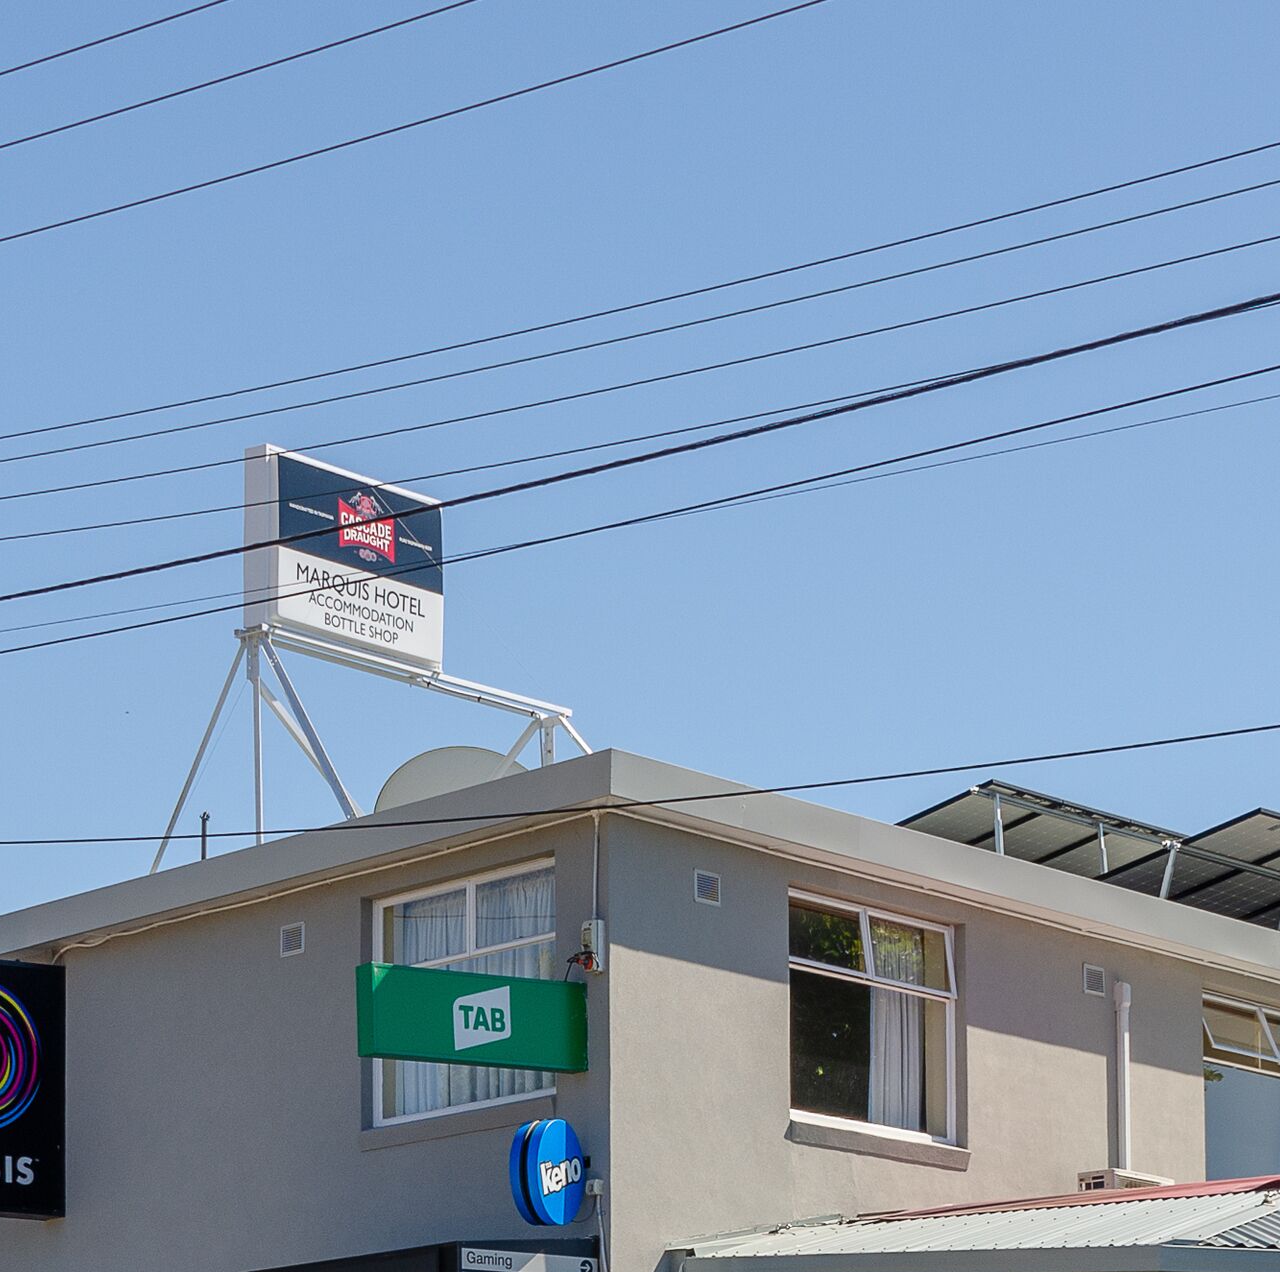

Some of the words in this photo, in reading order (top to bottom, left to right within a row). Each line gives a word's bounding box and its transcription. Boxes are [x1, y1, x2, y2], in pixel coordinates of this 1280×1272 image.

[344, 528, 390, 552] DRAUGHT
[296, 562, 369, 601] MARQUIS
[375, 586, 425, 618] HOTEL
[308, 592, 414, 632] ACCOMMODATION
[324, 613, 366, 636] BOTTLE
[369, 625, 399, 644] SHOP
[458, 1004, 506, 1032] TAB
[466, 1251, 513, 1269] Gaming
